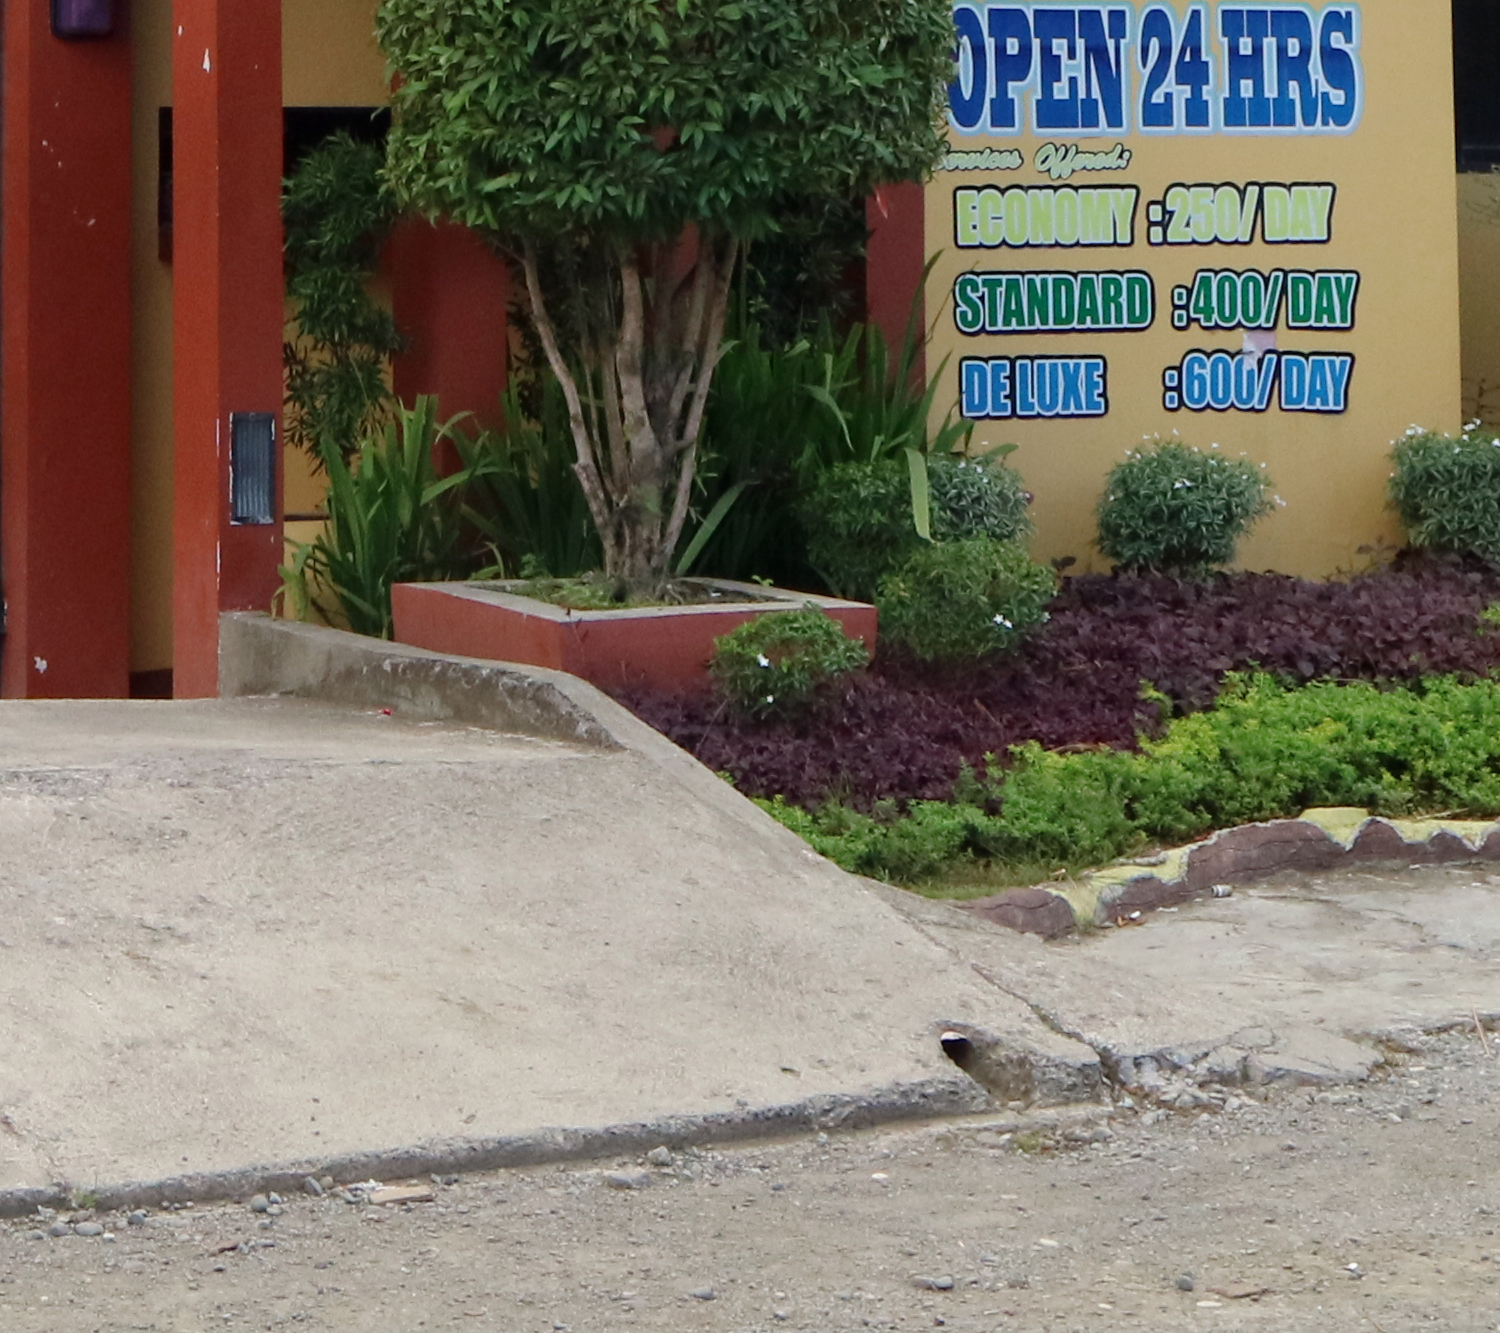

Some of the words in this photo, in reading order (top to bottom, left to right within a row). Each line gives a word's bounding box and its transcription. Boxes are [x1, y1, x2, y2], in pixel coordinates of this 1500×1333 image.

[947, 4, 1131, 133] OPEN
[1137, 5, 1212, 133] 24
[1216, 3, 1360, 134] HRS
[1034, 143, 1132, 180] Offered:
[955, 185, 1138, 247] ECONOMY
[1261, 183, 1335, 244] DAY
[954, 271, 1155, 332] STANDARD
[1285, 270, 1360, 330] DAY
[960, 356, 1012, 418] DE
[1014, 355, 1108, 417] LUXE
[1280, 351, 1355, 413] DAY
